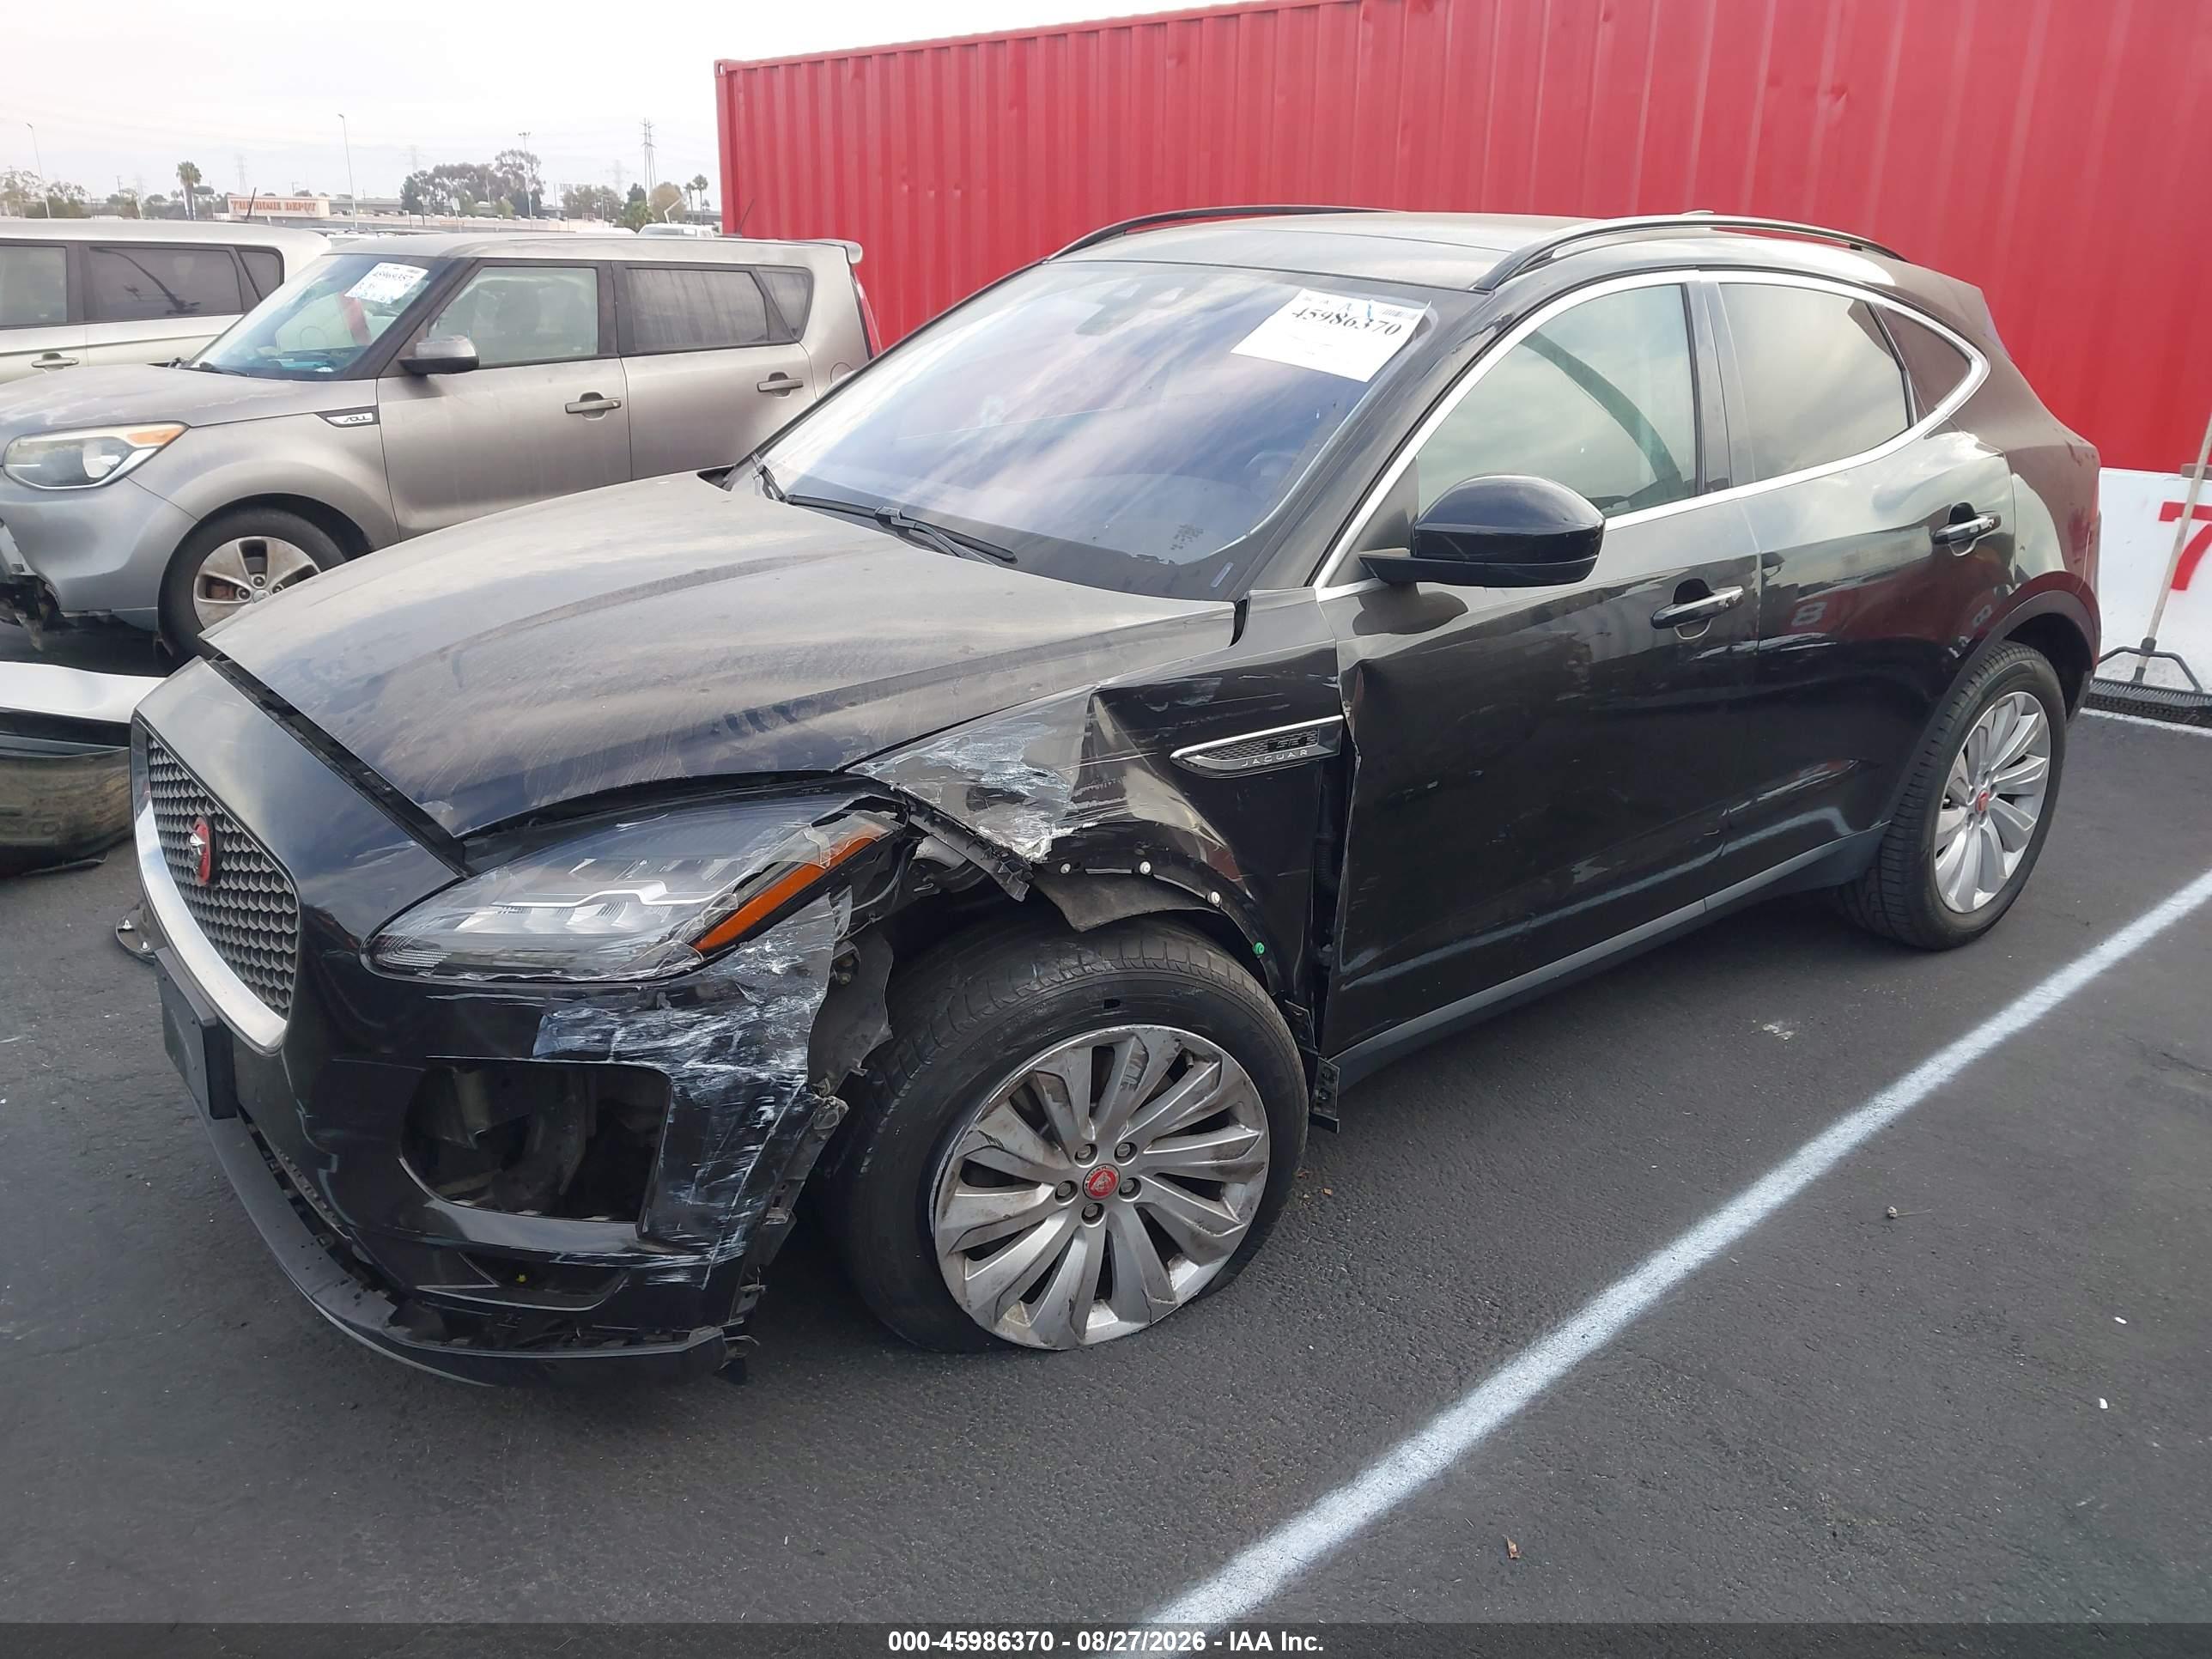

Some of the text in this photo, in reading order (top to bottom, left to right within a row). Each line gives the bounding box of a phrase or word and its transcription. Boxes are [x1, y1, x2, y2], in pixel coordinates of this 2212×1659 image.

[285, 201, 316, 211] DEPOT
[1291, 307, 1402, 336] 45986370
[343, 415, 372, 423] SOUL
[1241, 749, 1309, 767] JAGUAR
